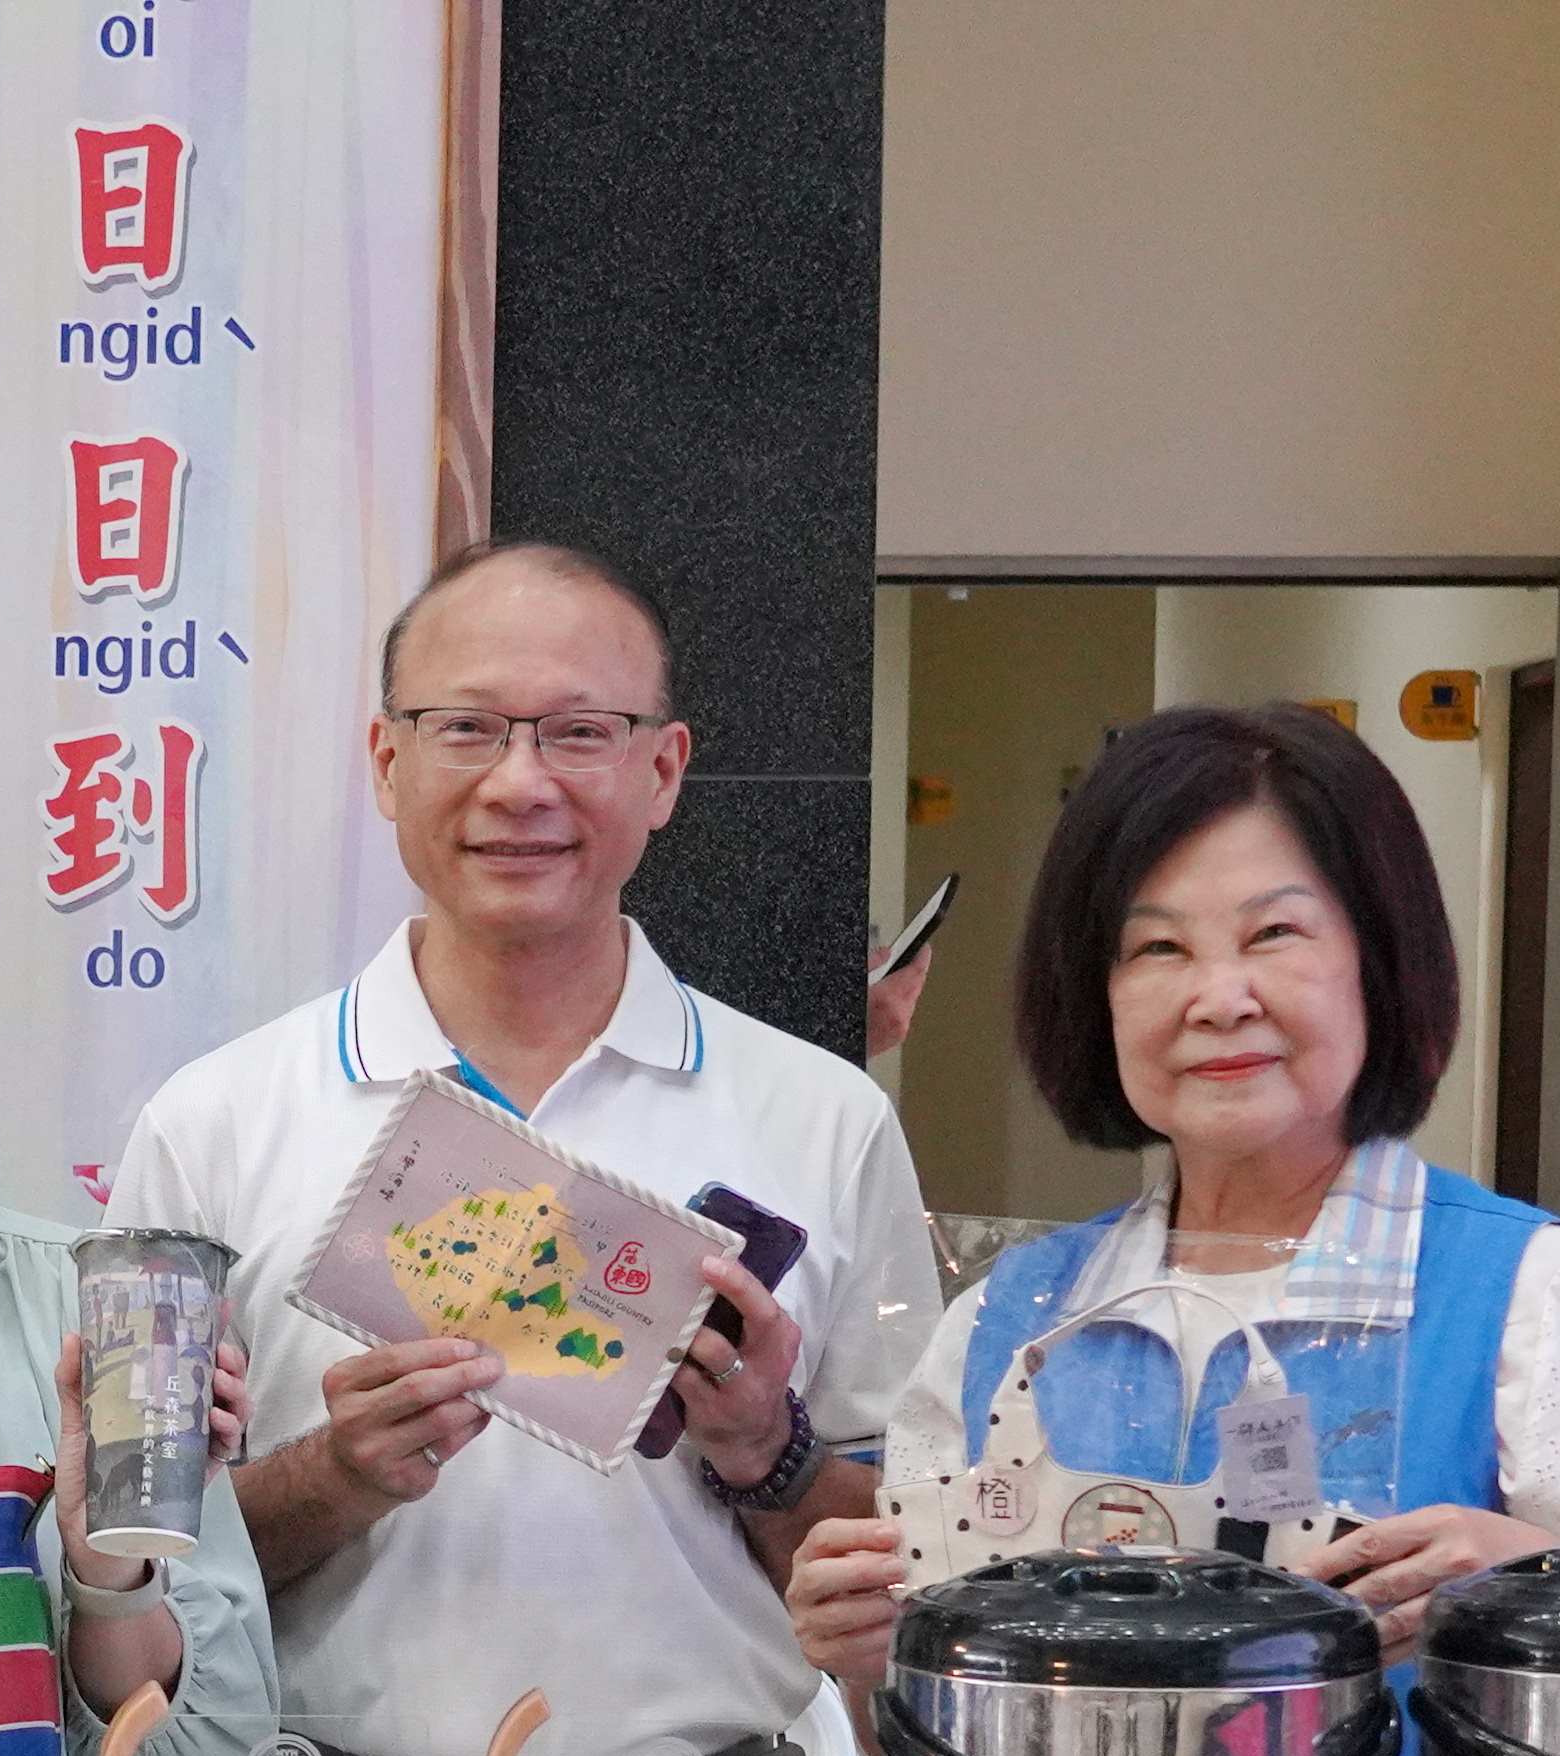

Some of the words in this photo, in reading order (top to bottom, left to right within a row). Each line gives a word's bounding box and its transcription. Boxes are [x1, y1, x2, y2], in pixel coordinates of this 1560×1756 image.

[74, 124, 184, 281] 日
[68, 437, 179, 593] 日
[44, 724, 193, 915] 到
[85, 929, 166, 990] do
